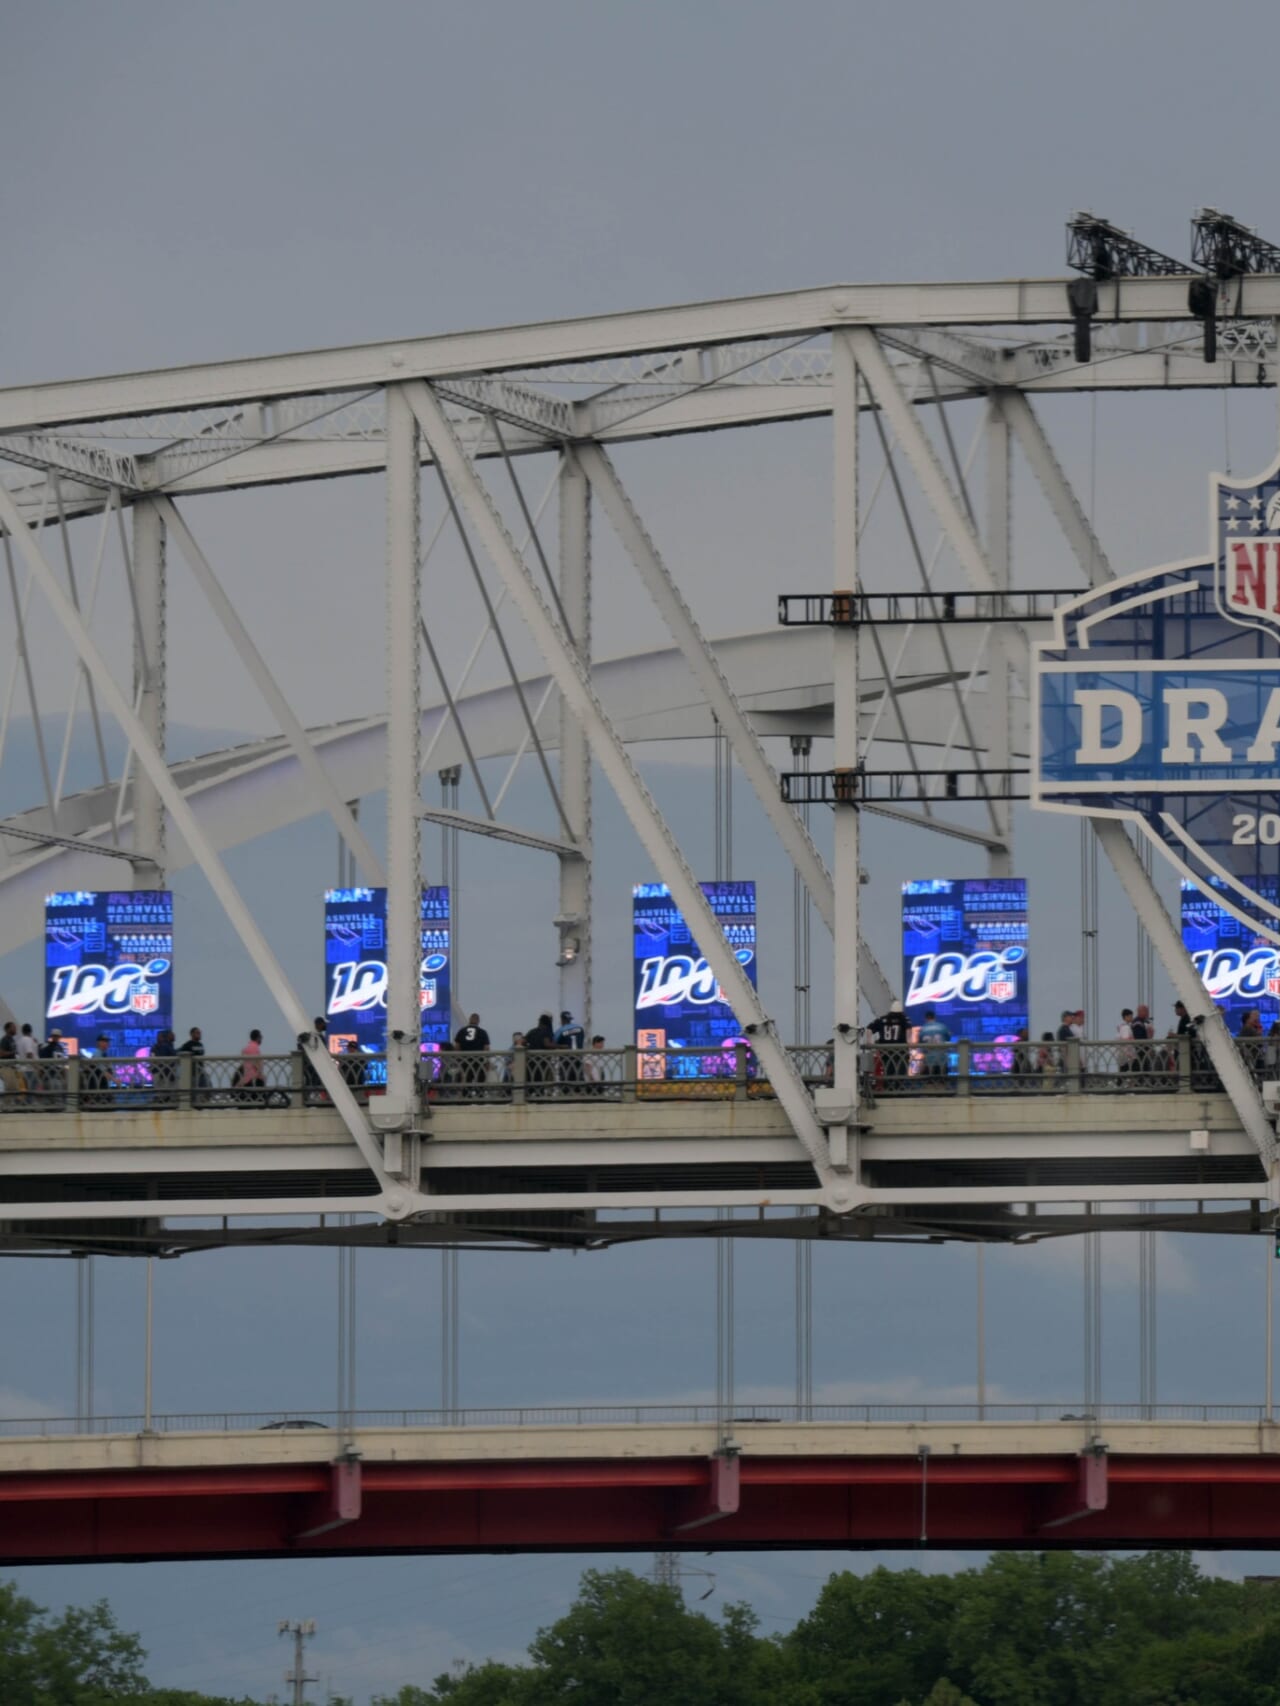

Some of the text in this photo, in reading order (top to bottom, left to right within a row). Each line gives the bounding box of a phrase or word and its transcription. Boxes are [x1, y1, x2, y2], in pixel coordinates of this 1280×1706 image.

[47, 964, 145, 1018] 100
[328, 961, 388, 1015] 10
[905, 951, 1003, 1007] 100
[990, 983, 1012, 997] NFL
[134, 996, 154, 1009] NFL
[465, 1027, 476, 1041] 3
